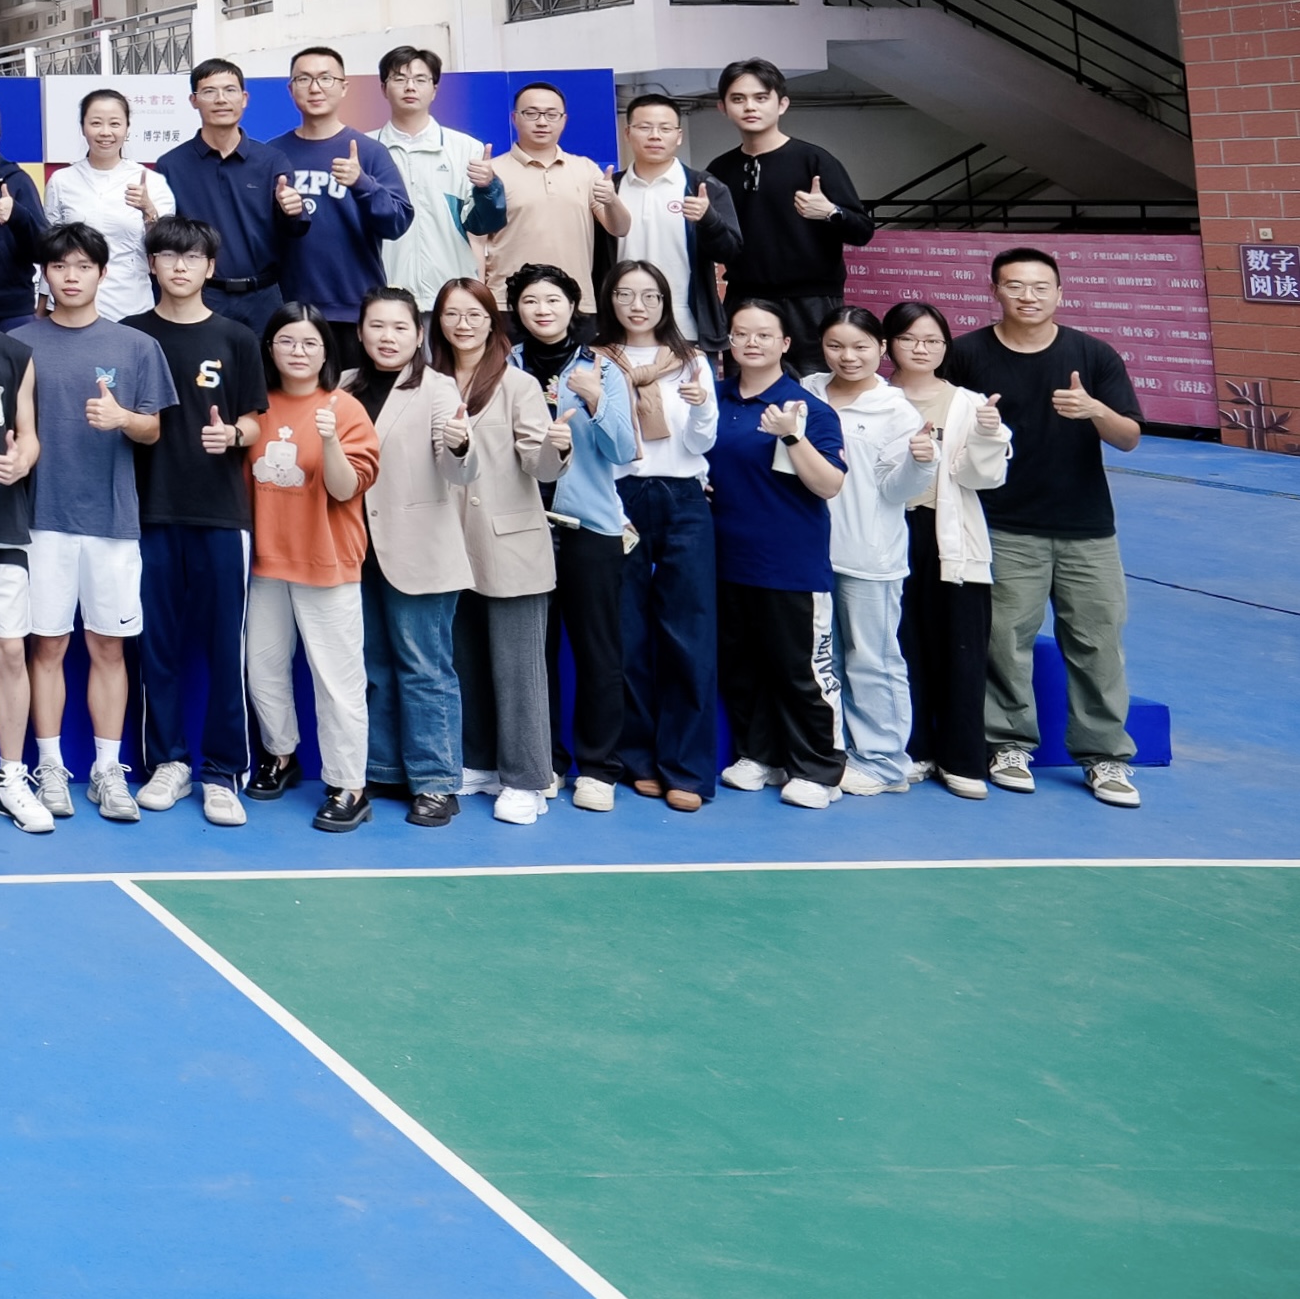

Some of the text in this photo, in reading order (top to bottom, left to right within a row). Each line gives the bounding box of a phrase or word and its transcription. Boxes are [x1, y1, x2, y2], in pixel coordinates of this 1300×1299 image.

[293, 170, 347, 199] ZPU
[1246, 249, 1296, 273] 数字
[1250, 274, 1299, 298] 阅读
